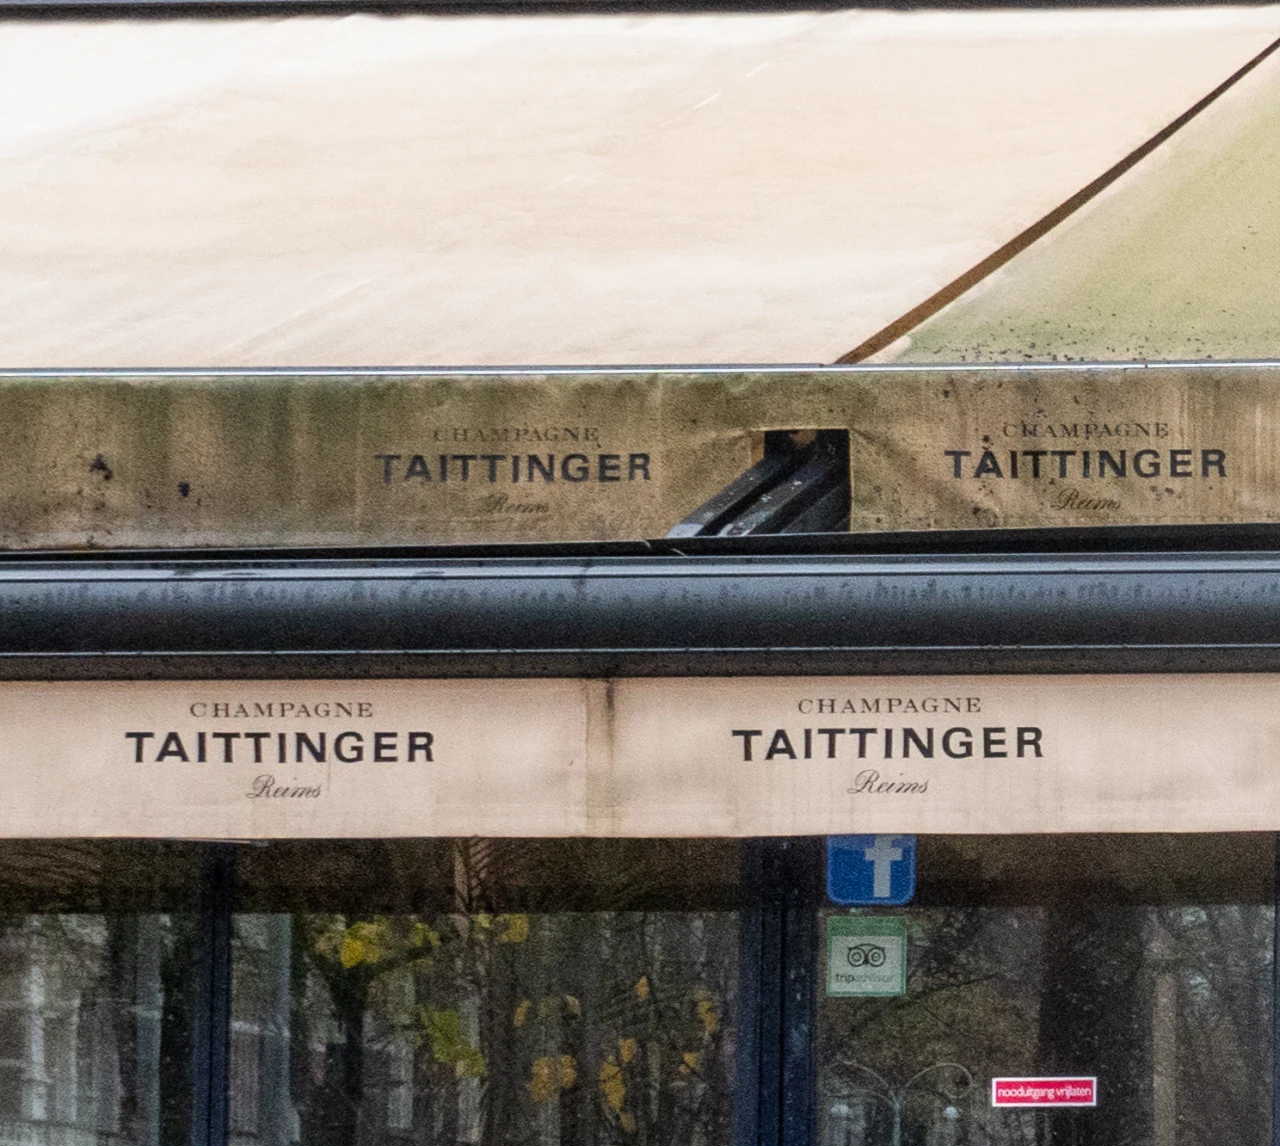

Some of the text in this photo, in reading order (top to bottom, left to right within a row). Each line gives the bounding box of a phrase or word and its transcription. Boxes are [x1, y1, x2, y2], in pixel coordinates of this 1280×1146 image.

[432, 427, 599, 443] CHAMPAGNE
[1003, 422, 1170, 439] CHAMPAGNE
[375, 453, 651, 484] TAITTINGER
[944, 449, 1228, 479] TAITTINGER
[1050, 488, 1122, 511] Reims
[189, 702, 373, 718] CHAMPAGNE
[798, 697, 982, 715] CHAMPAGNE
[125, 731, 435, 764] TAITTINGER
[732, 727, 1044, 761] TAITTINGER
[246, 773, 321, 798] Reims
[848, 769, 929, 795] Reims
[997, 1085, 1055, 1100] nooduitgang
